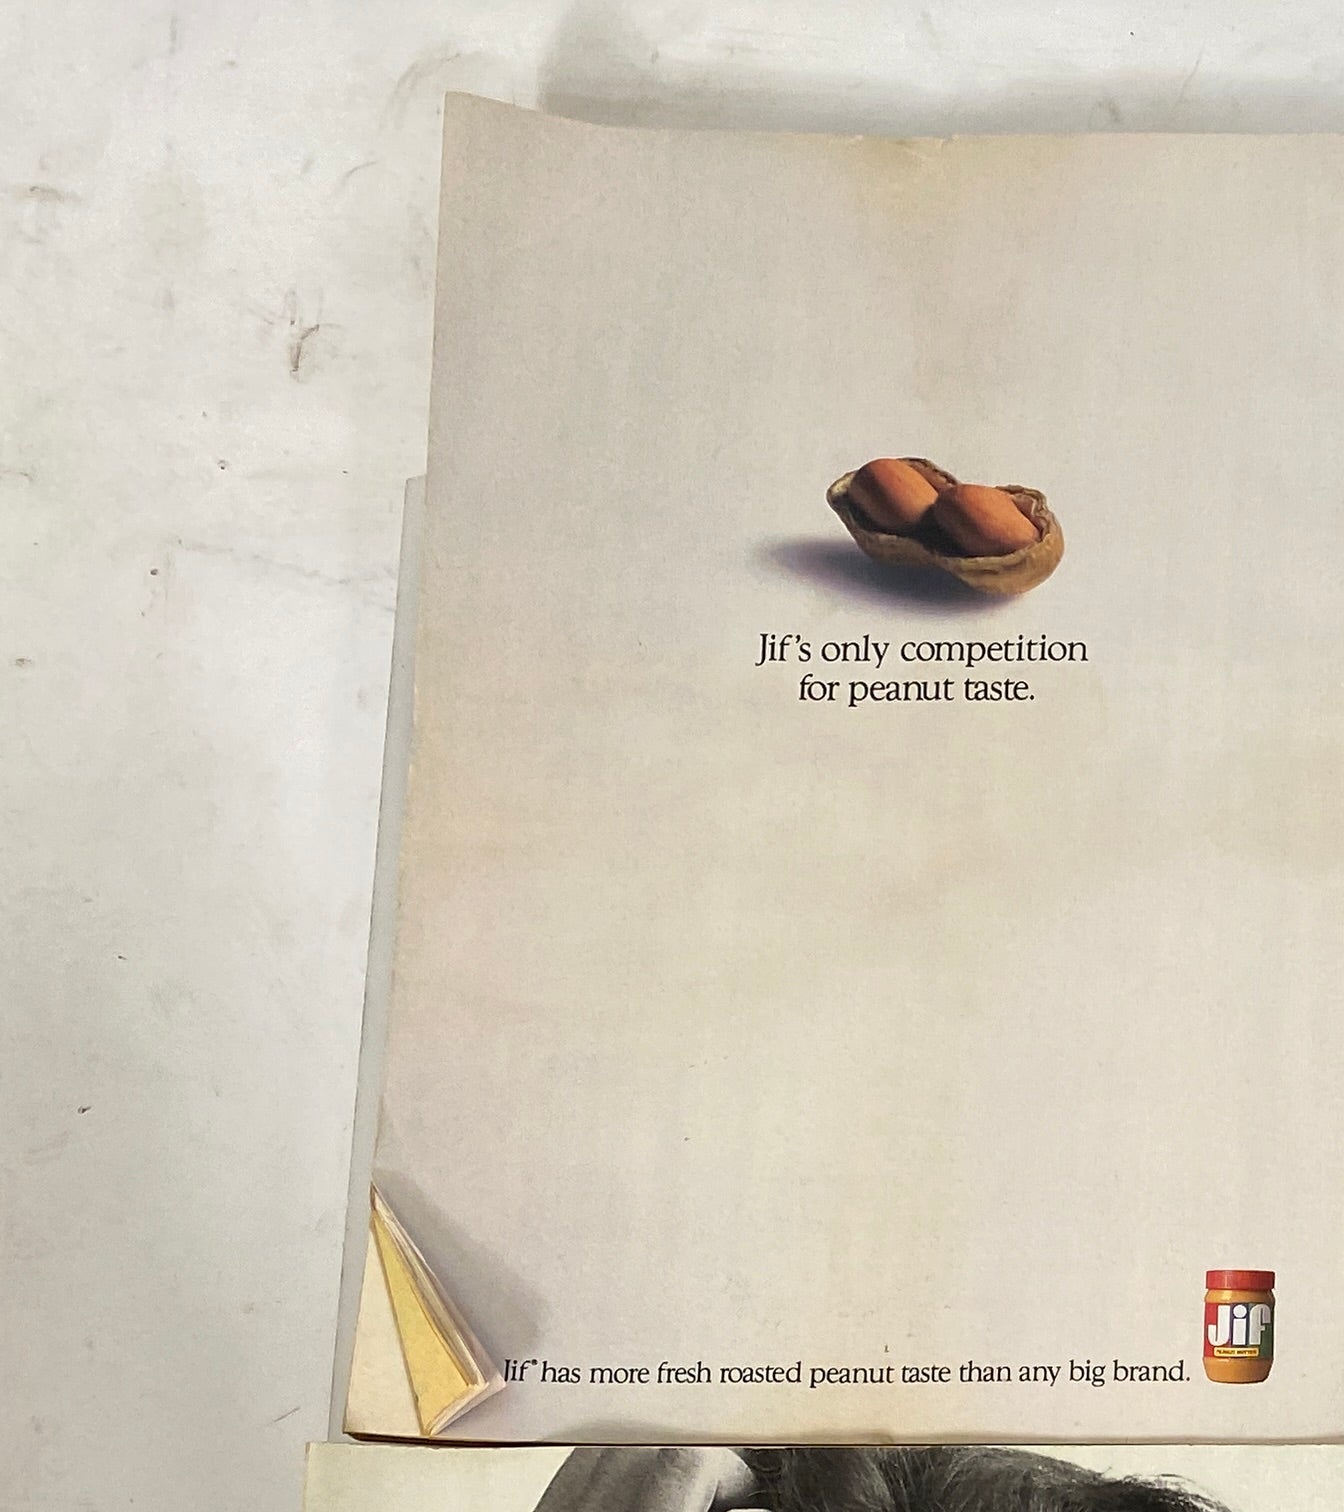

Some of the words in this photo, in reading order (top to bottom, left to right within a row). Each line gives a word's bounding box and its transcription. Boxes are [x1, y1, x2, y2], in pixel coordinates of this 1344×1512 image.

[755, 633, 811, 666] Jif's
[821, 634, 890, 669] only
[901, 634, 1088, 668] competition
[799, 673, 840, 701] for
[848, 678, 955, 707] peanut
[964, 678, 1034, 701] taste.
[1207, 1304, 1271, 1347] Jif
[541, 1361, 581, 1384] has
[590, 1368, 650, 1384] more
[657, 1361, 712, 1384] fresh
[720, 1361, 802, 1383] roasted
[809, 1366, 895, 1389] peanut
[902, 1365, 951, 1383] taste
[959, 1360, 1012, 1382] than
[1019, 1366, 1061, 1387] any
[1069, 1359, 1106, 1387] big
[1113, 1359, 1190, 1381] brand.
